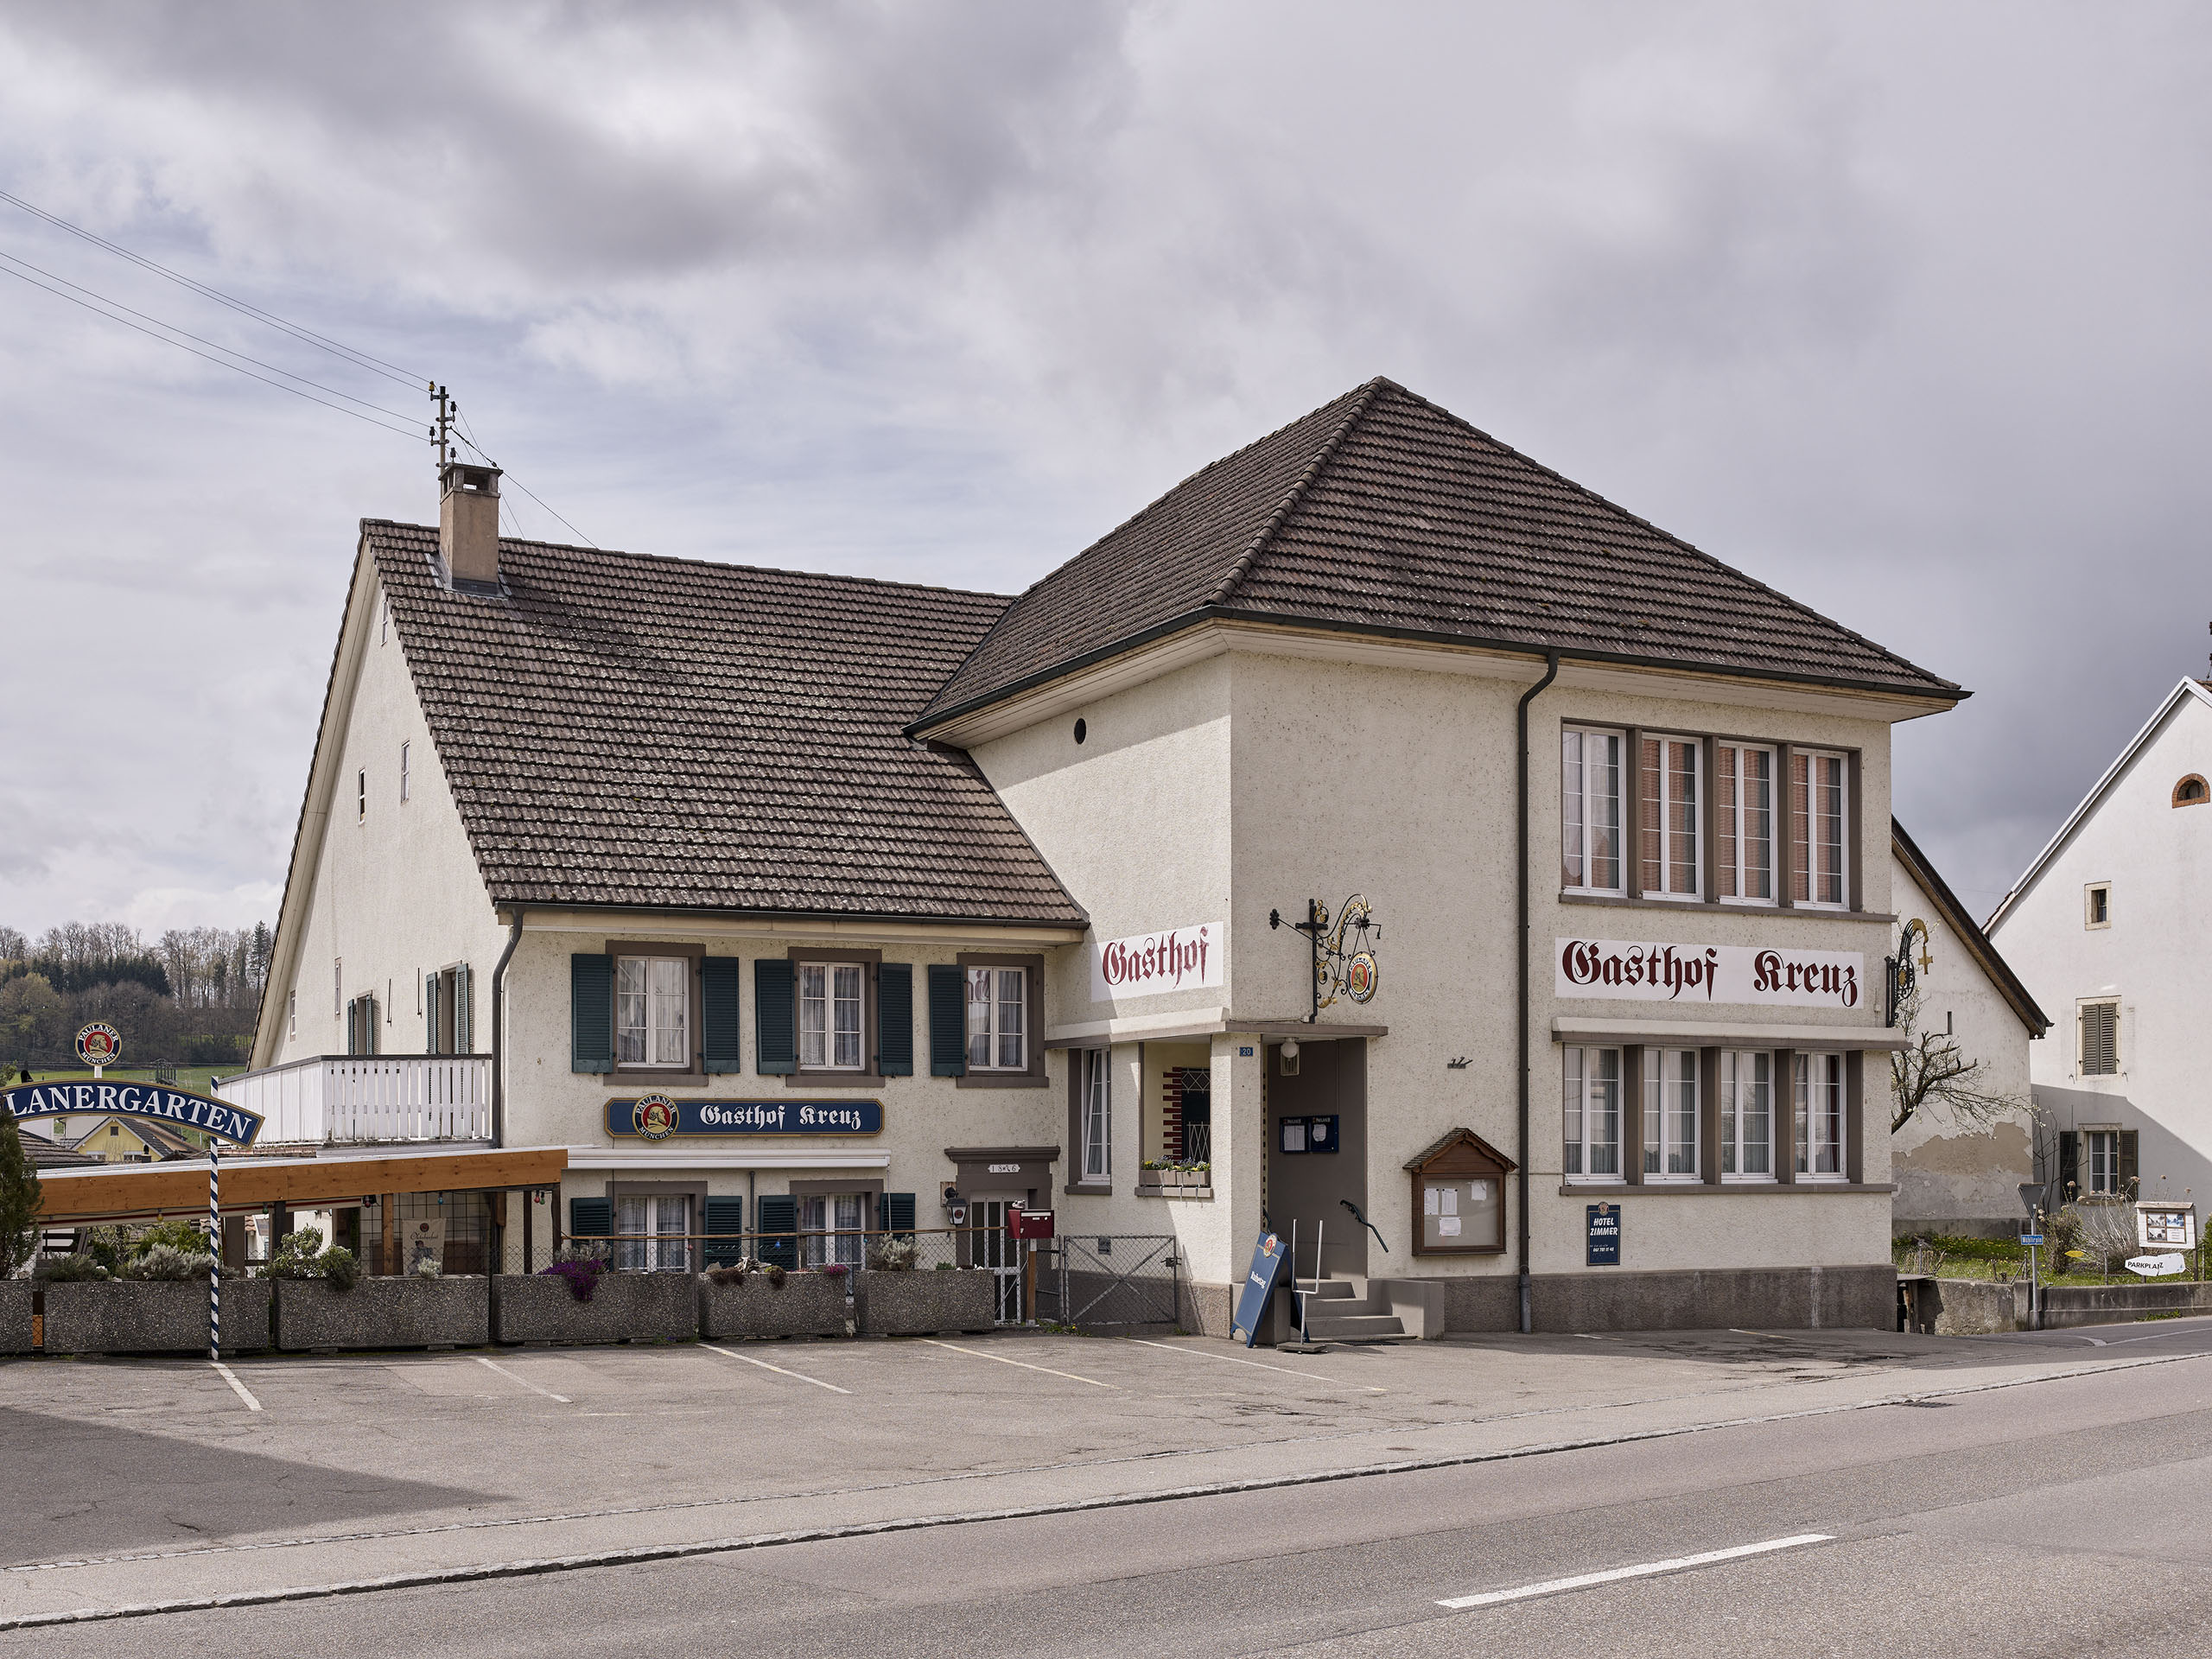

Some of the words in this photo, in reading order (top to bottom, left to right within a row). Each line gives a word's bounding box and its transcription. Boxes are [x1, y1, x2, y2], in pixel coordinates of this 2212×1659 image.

[1103, 925, 1210, 988] Gasthof
[1562, 940, 1718, 1001] Gasthof
[1753, 950, 1858, 1007] Kreuz
[79, 1025, 118, 1042] PAULANER
[3, 1085, 252, 1140] LANERGARTEN
[636, 1096, 677, 1114] PAULANER
[700, 1104, 785, 1129] Gasthof
[799, 1105, 861, 1130] Kreuz
[1593, 1217, 1614, 1226] HOTEL
[1590, 1227, 1618, 1236] ZIMMER
[2127, 1261, 2164, 1269] PARKPLATZ
